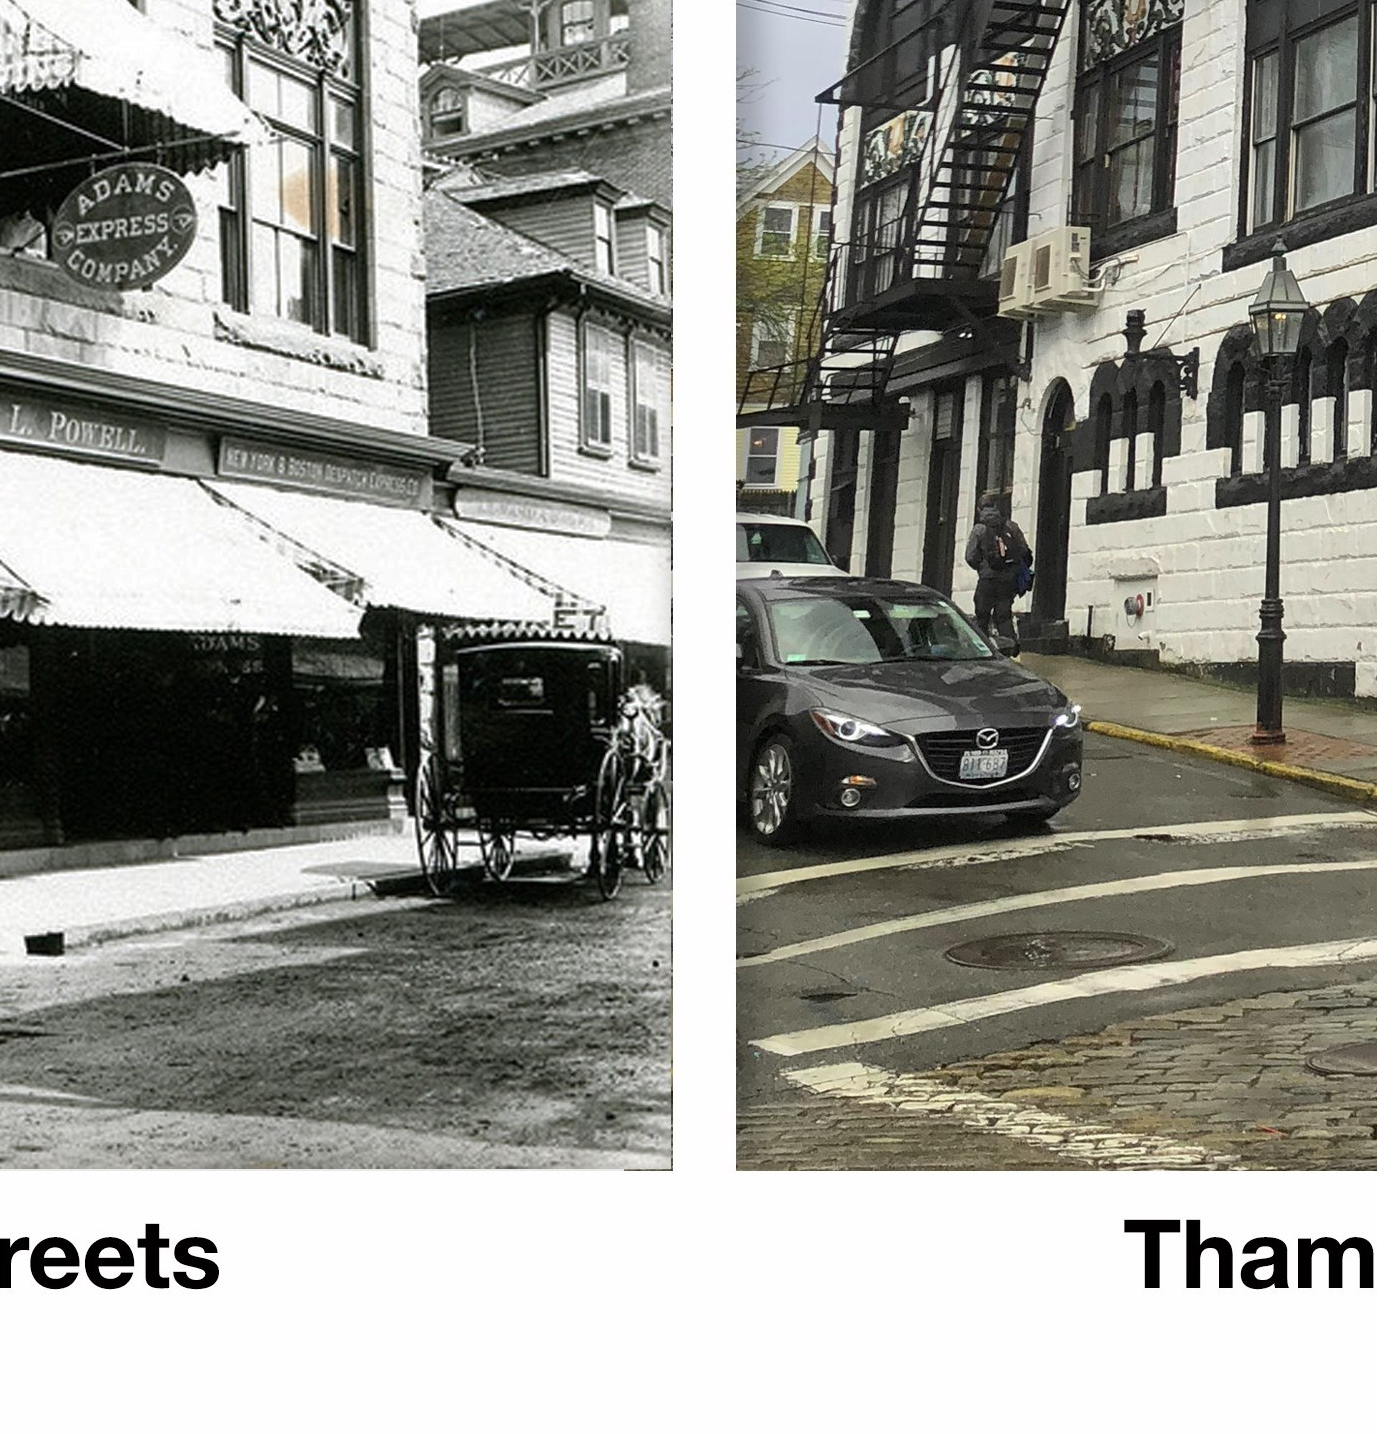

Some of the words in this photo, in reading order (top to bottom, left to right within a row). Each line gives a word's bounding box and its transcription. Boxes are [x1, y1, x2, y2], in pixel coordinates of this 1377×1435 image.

[77, 173, 175, 216] ADAMS
[76, 213, 168, 244] EXPRESS
[67, 235, 179, 283] COMPANY.
[8, 404, 33, 435] L.
[226, 447, 249, 469] NEW
[251, 451, 276, 472] YORK
